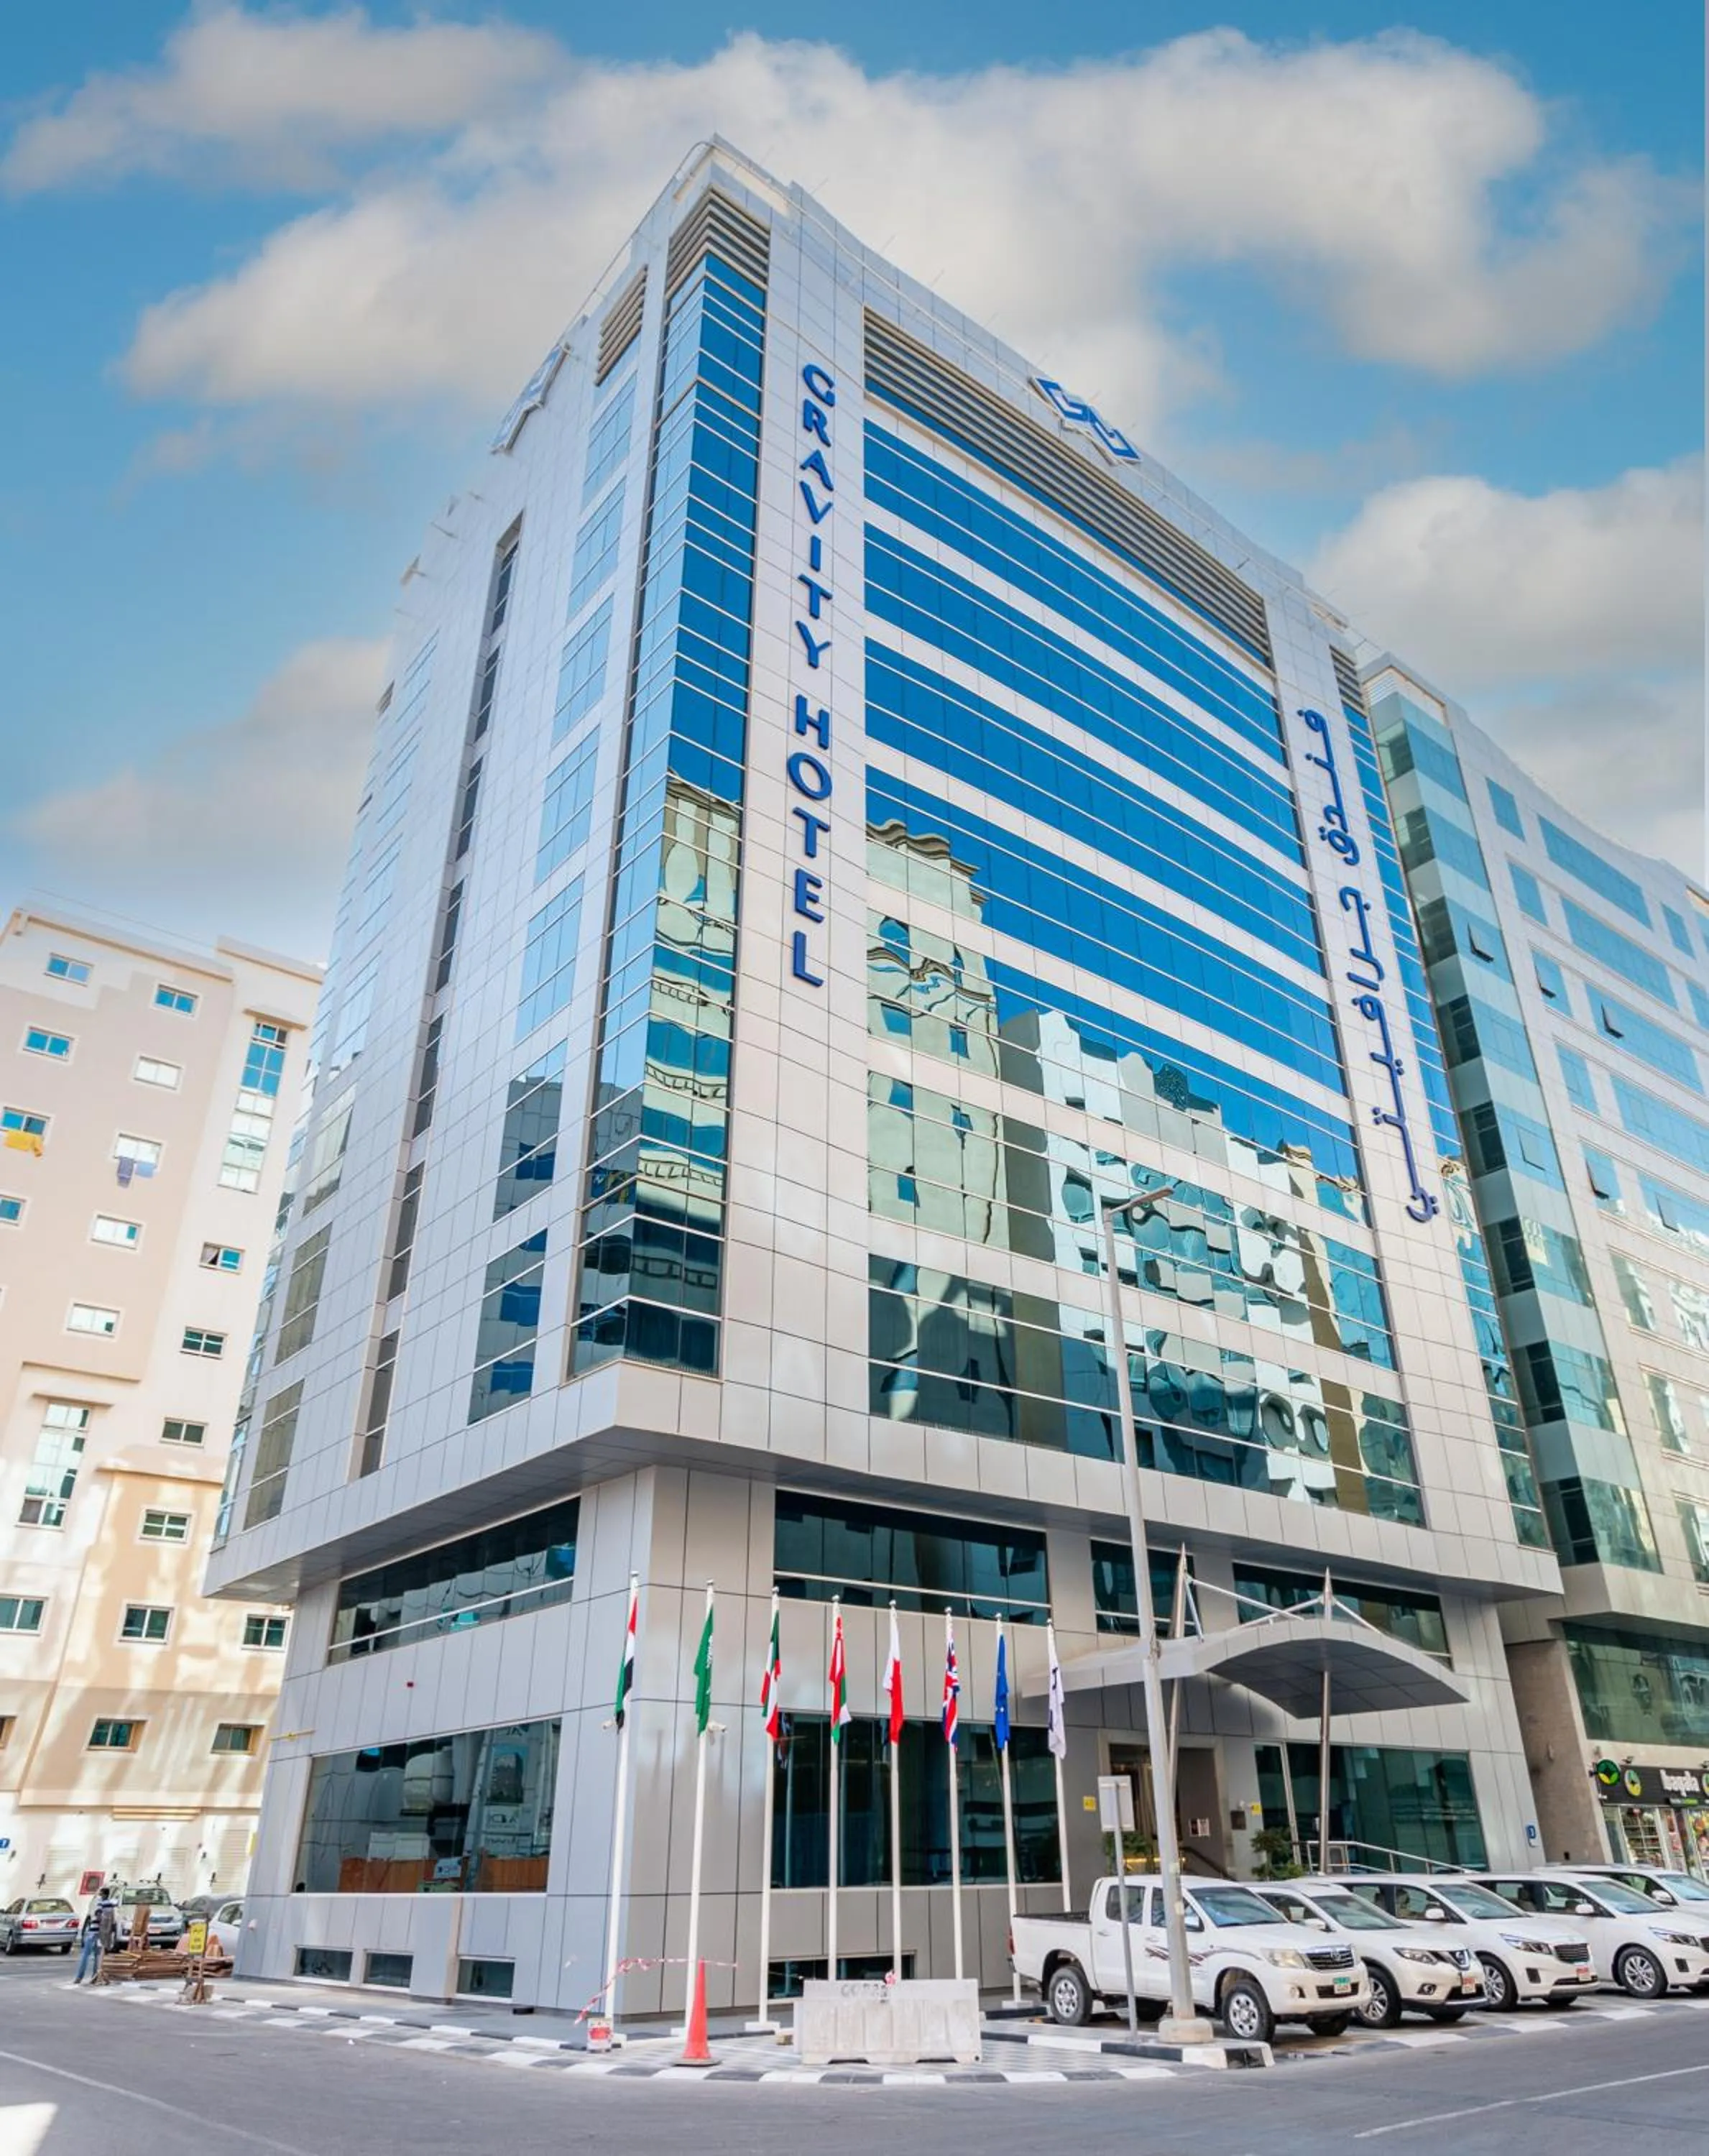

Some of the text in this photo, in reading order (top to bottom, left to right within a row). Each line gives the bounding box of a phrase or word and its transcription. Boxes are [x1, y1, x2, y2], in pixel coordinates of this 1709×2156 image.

[787, 362, 837, 985] GRAVITY HOTEL
[1296, 709, 1439, 1223] فندق جرافيتي
